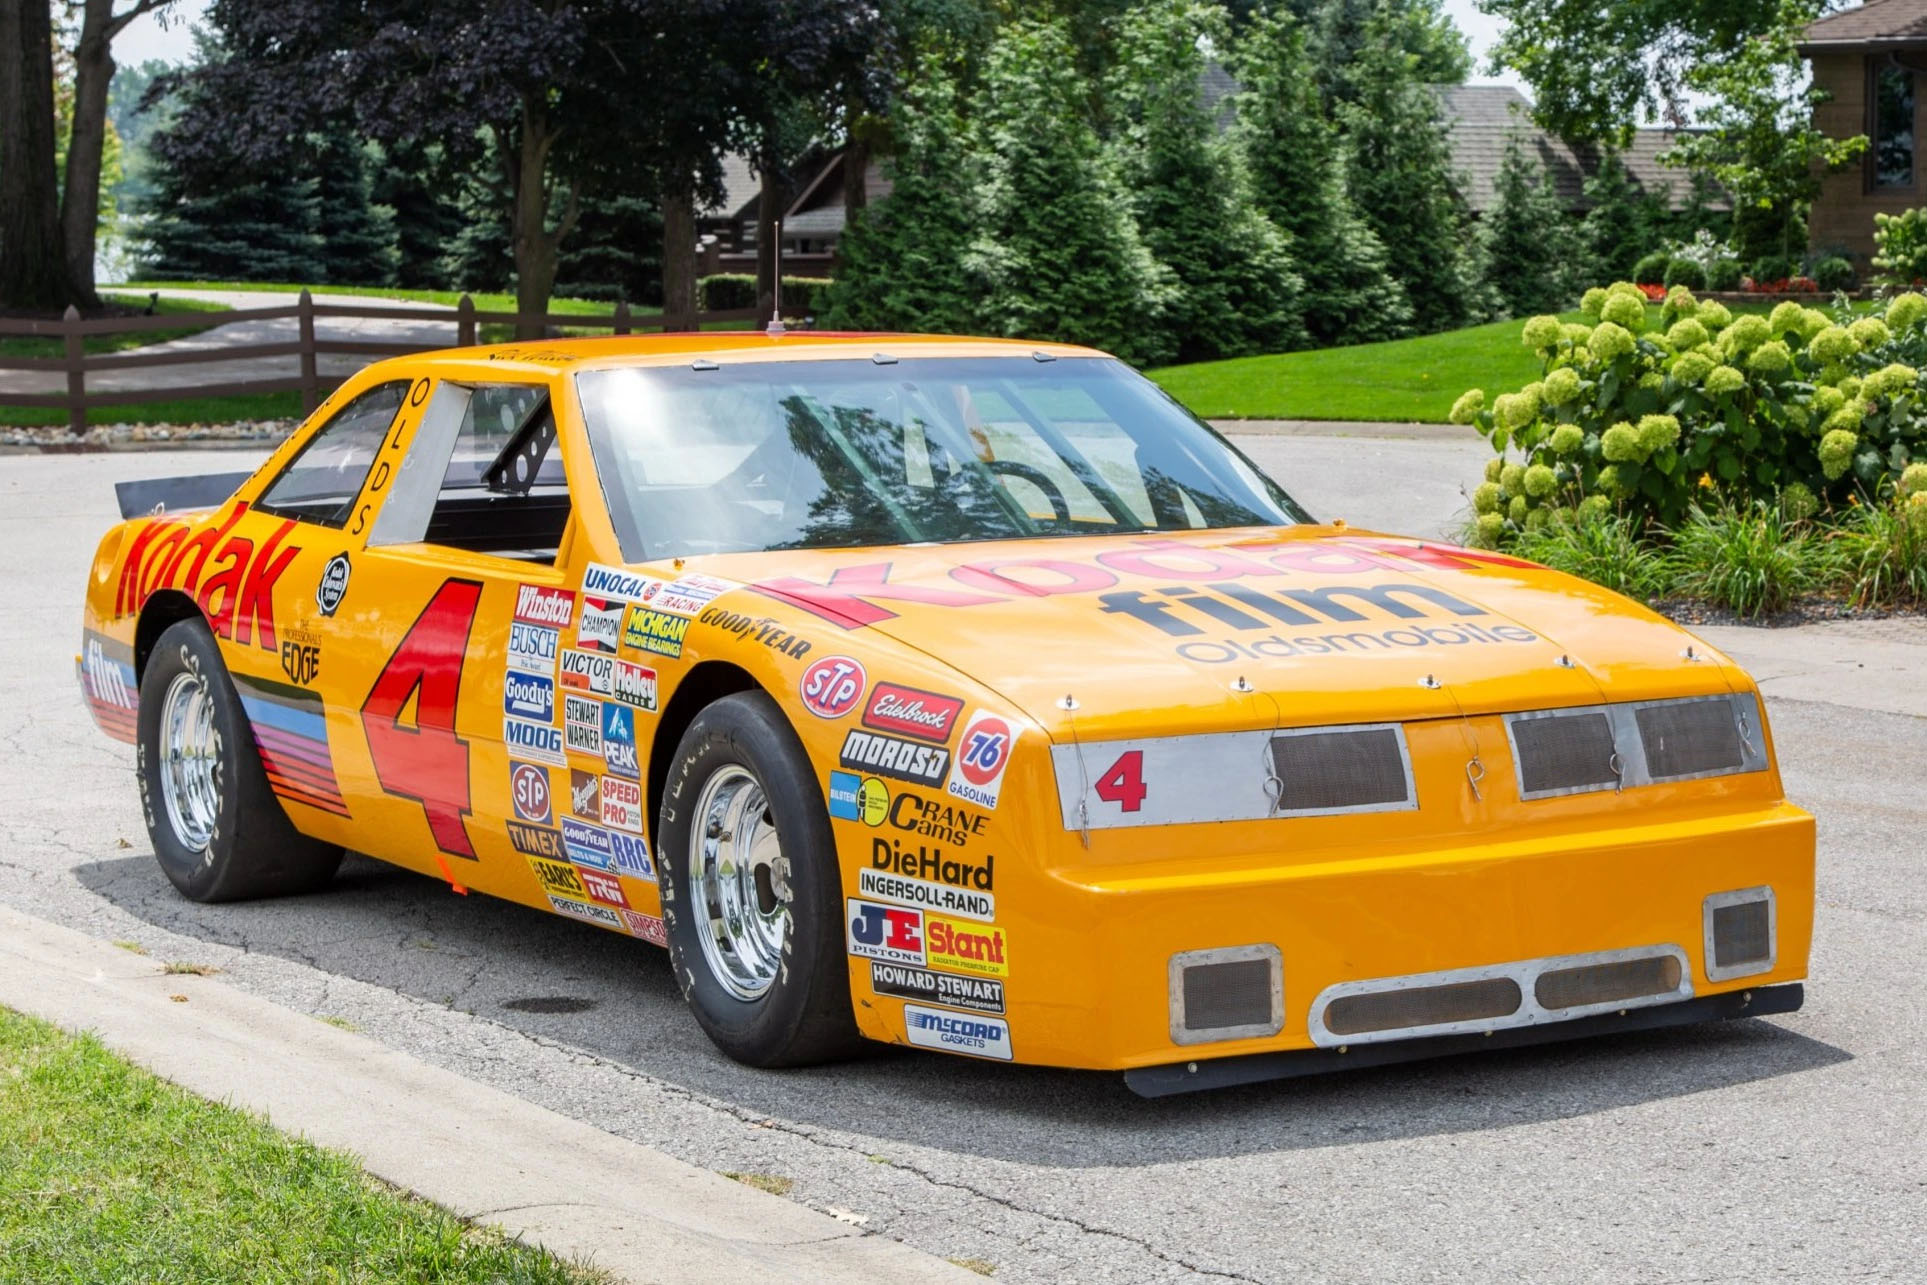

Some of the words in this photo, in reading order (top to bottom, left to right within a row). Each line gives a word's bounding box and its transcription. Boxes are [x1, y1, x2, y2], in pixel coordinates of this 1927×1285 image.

[352, 377, 430, 536] OLDS
[115, 501, 302, 653] Kodak
[584, 568, 647, 598] UNOCAL
[745, 536, 1550, 631] Kodak
[515, 585, 573, 626] Winston
[664, 596, 704, 612] RACING
[1098, 582, 1488, 637] film
[509, 625, 558, 659] BUSCH
[581, 613, 621, 637] CHAMPION
[629, 606, 688, 642] MICHIGAN
[625, 633, 648, 649] ENGINE
[649, 637, 682, 655] BEARINGS
[1176, 623, 1538, 664] Oldsmobile
[87, 638, 132, 709] film
[282, 640, 320, 685] EDGE
[563, 651, 612, 680] VICTOR
[506, 677, 553, 713] Goody's
[616, 661, 657, 709] Holley
[806, 662, 857, 709] STP
[360, 577, 484, 862] 4
[567, 698, 599, 726] STEWART
[873, 694, 949, 728] Edelbrock
[506, 720, 562, 753] MOOG
[567, 723, 600, 752] WARNER
[963, 730, 1008, 771] 76
[603, 740, 638, 770] PEAK
[841, 730, 950, 780] MOROSO
[517, 771, 544, 810] STP
[602, 779, 640, 806] SPEED
[949, 782, 996, 808] GASOLINE
[1094, 751, 1147, 813] 4
[602, 802, 627, 825] PRO
[889, 792, 991, 836] CRANE
[508, 825, 563, 859] TIMEX
[564, 826, 609, 849] GOODYEAR
[611, 832, 651, 874] BRC
[538, 861, 582, 891] EARL'S
[872, 837, 994, 890] DieHard
[582, 872, 625, 904] TRW
[861, 872, 990, 916] INGERSOLL-RAND
[551, 896, 586, 916] PERFECT
[587, 904, 619, 923] CIRCLE
[626, 912, 667, 938] SIMPSO
[852, 903, 922, 953] JE
[928, 920, 1004, 964] Stant
[853, 944, 922, 963] PISTONS
[873, 965, 936, 991] HOWARD
[938, 976, 1001, 1001] STEWART
[938, 993, 960, 1005] Engine
[961, 997, 1002, 1011] Components
[941, 1033, 985, 1049] GASKETS
